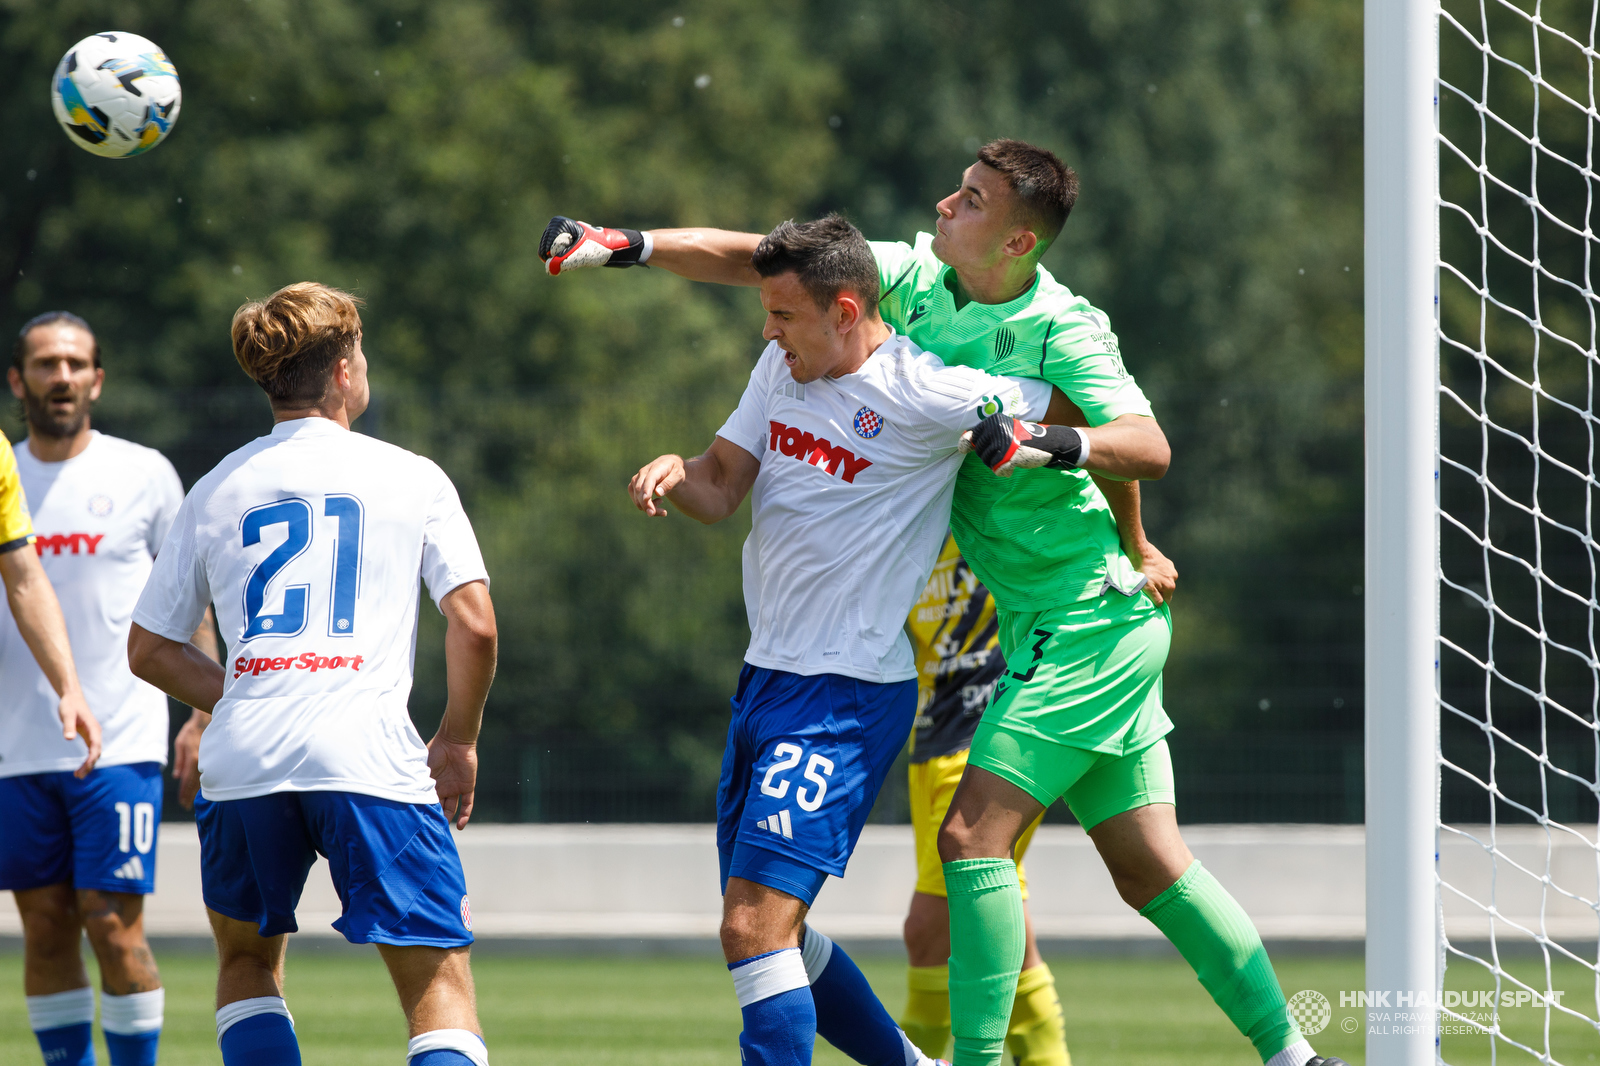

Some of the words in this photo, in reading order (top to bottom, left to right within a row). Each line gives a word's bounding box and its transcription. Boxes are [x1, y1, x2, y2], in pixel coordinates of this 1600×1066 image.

[769, 420, 874, 484] TOMMY
[34, 533, 105, 556] MMY
[239, 493, 365, 643] 21
[917, 567, 977, 604] MILY
[233, 652, 364, 679] SuperSport
[1004, 628, 1053, 683] 3
[760, 742, 834, 812] 25
[115, 801, 154, 854] 10
